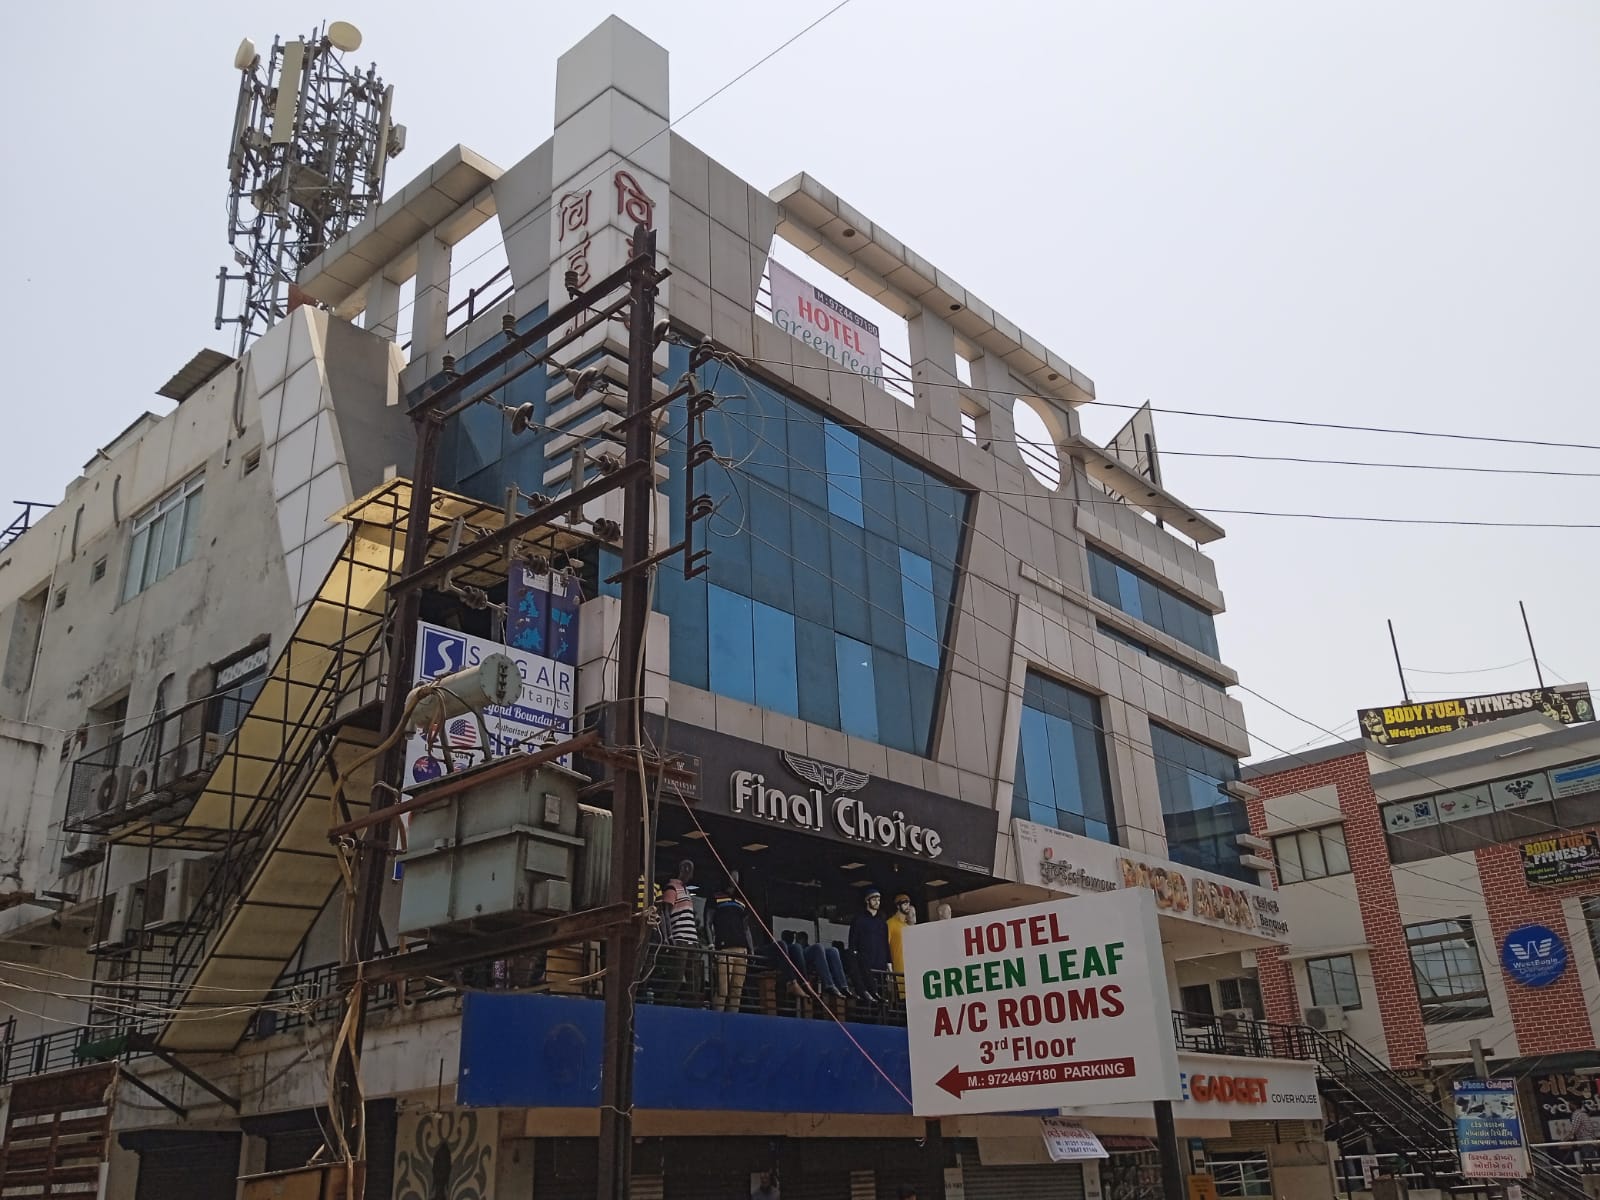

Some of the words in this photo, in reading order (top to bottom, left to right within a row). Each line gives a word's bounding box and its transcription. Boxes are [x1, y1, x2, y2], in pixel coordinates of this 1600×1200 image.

[775, 308, 838, 360] Green
[798, 296, 865, 355] HOTEL
[469, 646, 570, 693] SGAR
[1383, 706, 1426, 725] BODY
[1426, 700, 1465, 719] FUEL
[1465, 691, 1534, 715] FITNESS
[1388, 727, 1426, 739] Weight
[1427, 723, 1453, 736] Loss
[729, 770, 824, 831] Final
[831, 794, 943, 859] Choice
[1524, 840, 1557, 856] BODY
[1559, 835, 1592, 848] FUEL
[1533, 846, 1588, 865] FITNESS
[964, 912, 1069, 957] HOTEL
[922, 956, 1027, 1000] GREEN
[1039, 941, 1125, 984] LEAF
[933, 1001, 988, 1037] A/C
[997, 984, 1125, 1030] ROOMS
[979, 1037, 1008, 1065] 3rd
[1012, 1036, 1076, 1062] Floor
[987, 1068, 1057, 1086] 9724497180
[1064, 1062, 1125, 1079] PARKING
[1190, 1073, 1269, 1105] GADGET
[1486, 1080, 1513, 1090] Gadget
[1271, 1093, 1295, 1104] COVER
[1295, 1094, 1318, 1104] HOUSE
